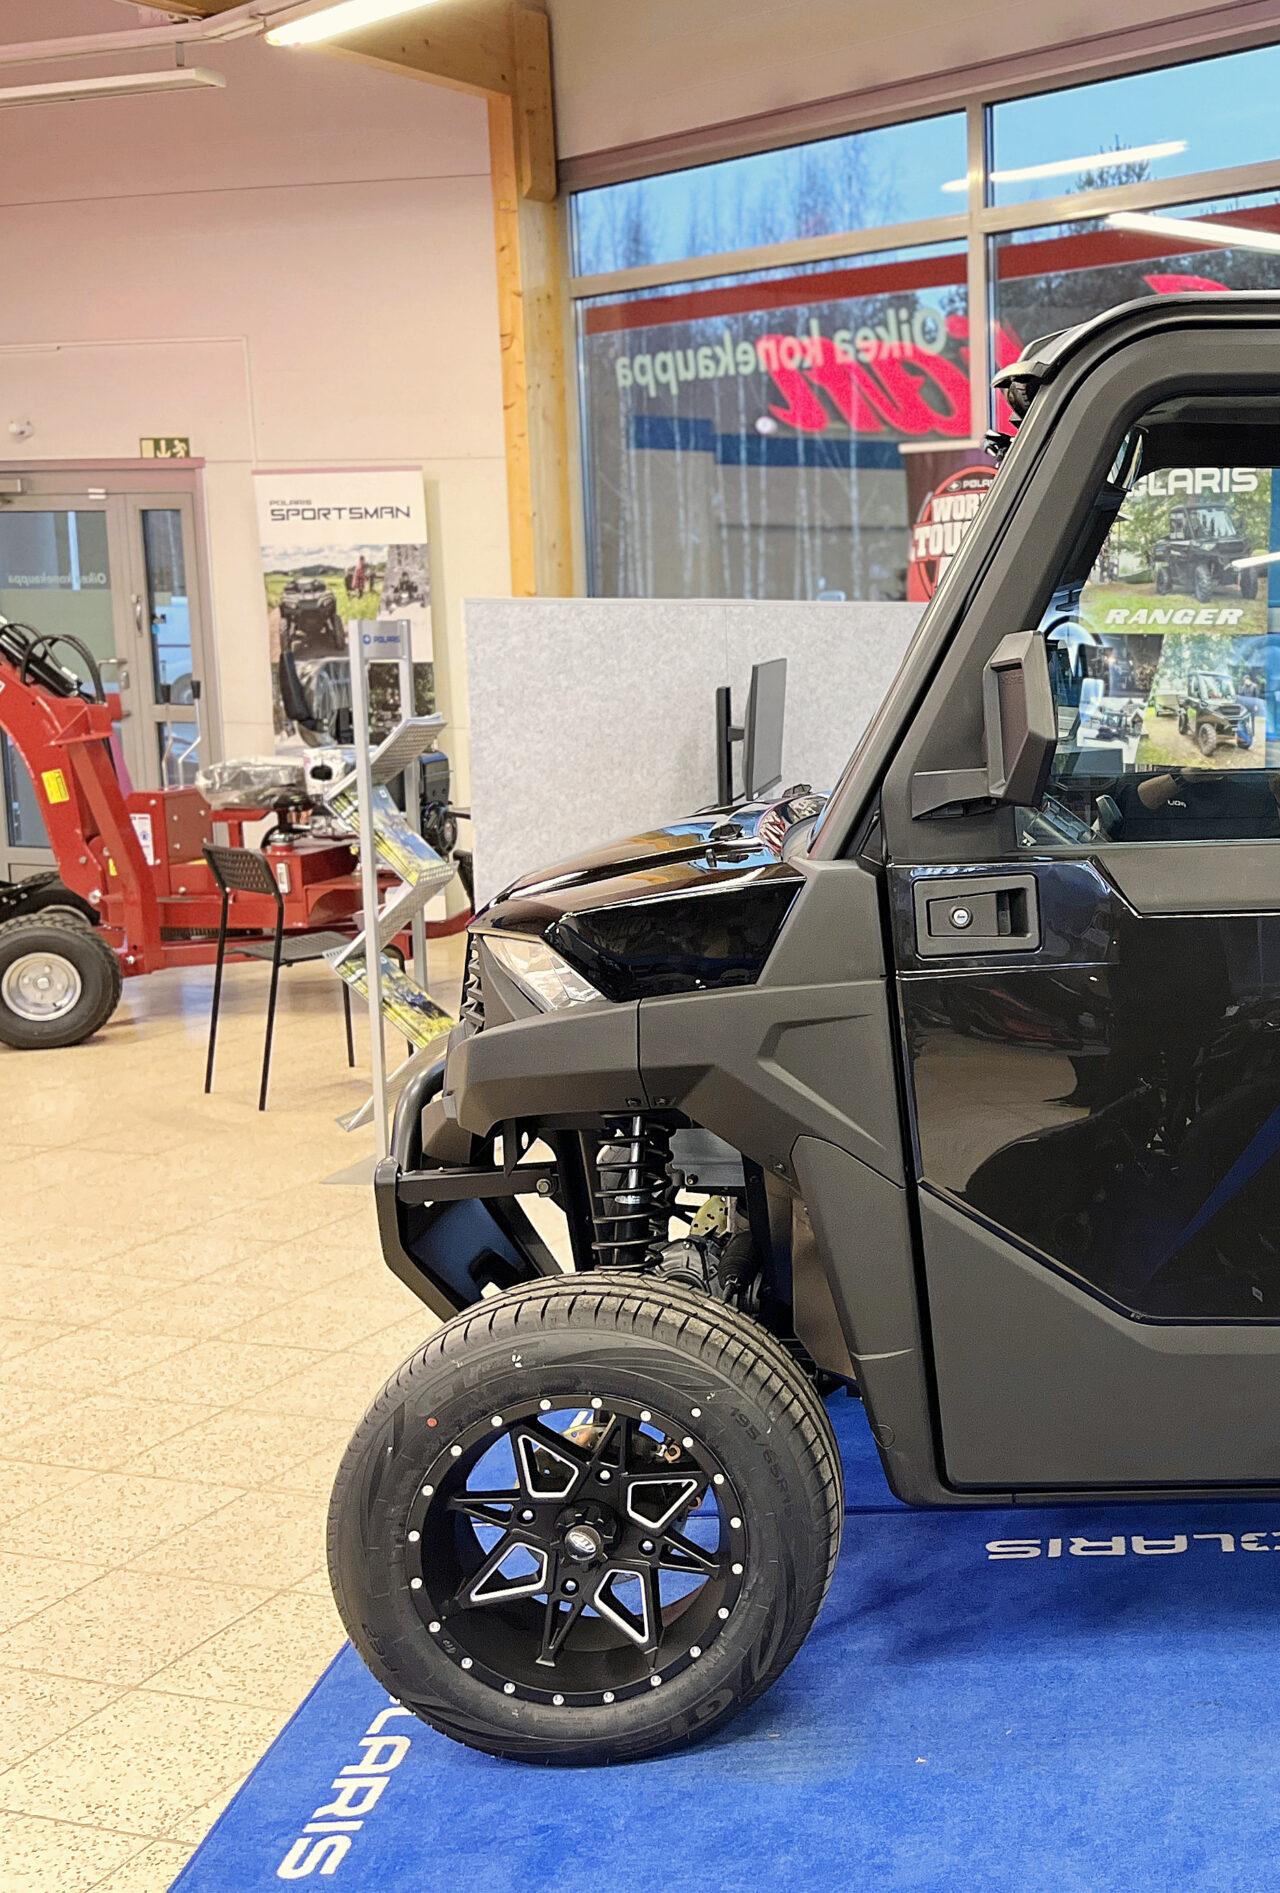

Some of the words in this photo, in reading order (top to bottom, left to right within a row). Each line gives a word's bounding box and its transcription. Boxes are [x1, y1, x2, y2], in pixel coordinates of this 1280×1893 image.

[1126, 467, 1258, 498] OLARIS
[270, 506, 411, 521] SPORTSMAN
[1104, 608, 1244, 625] RANGER
[277, 1695, 417, 1880] LARIS
